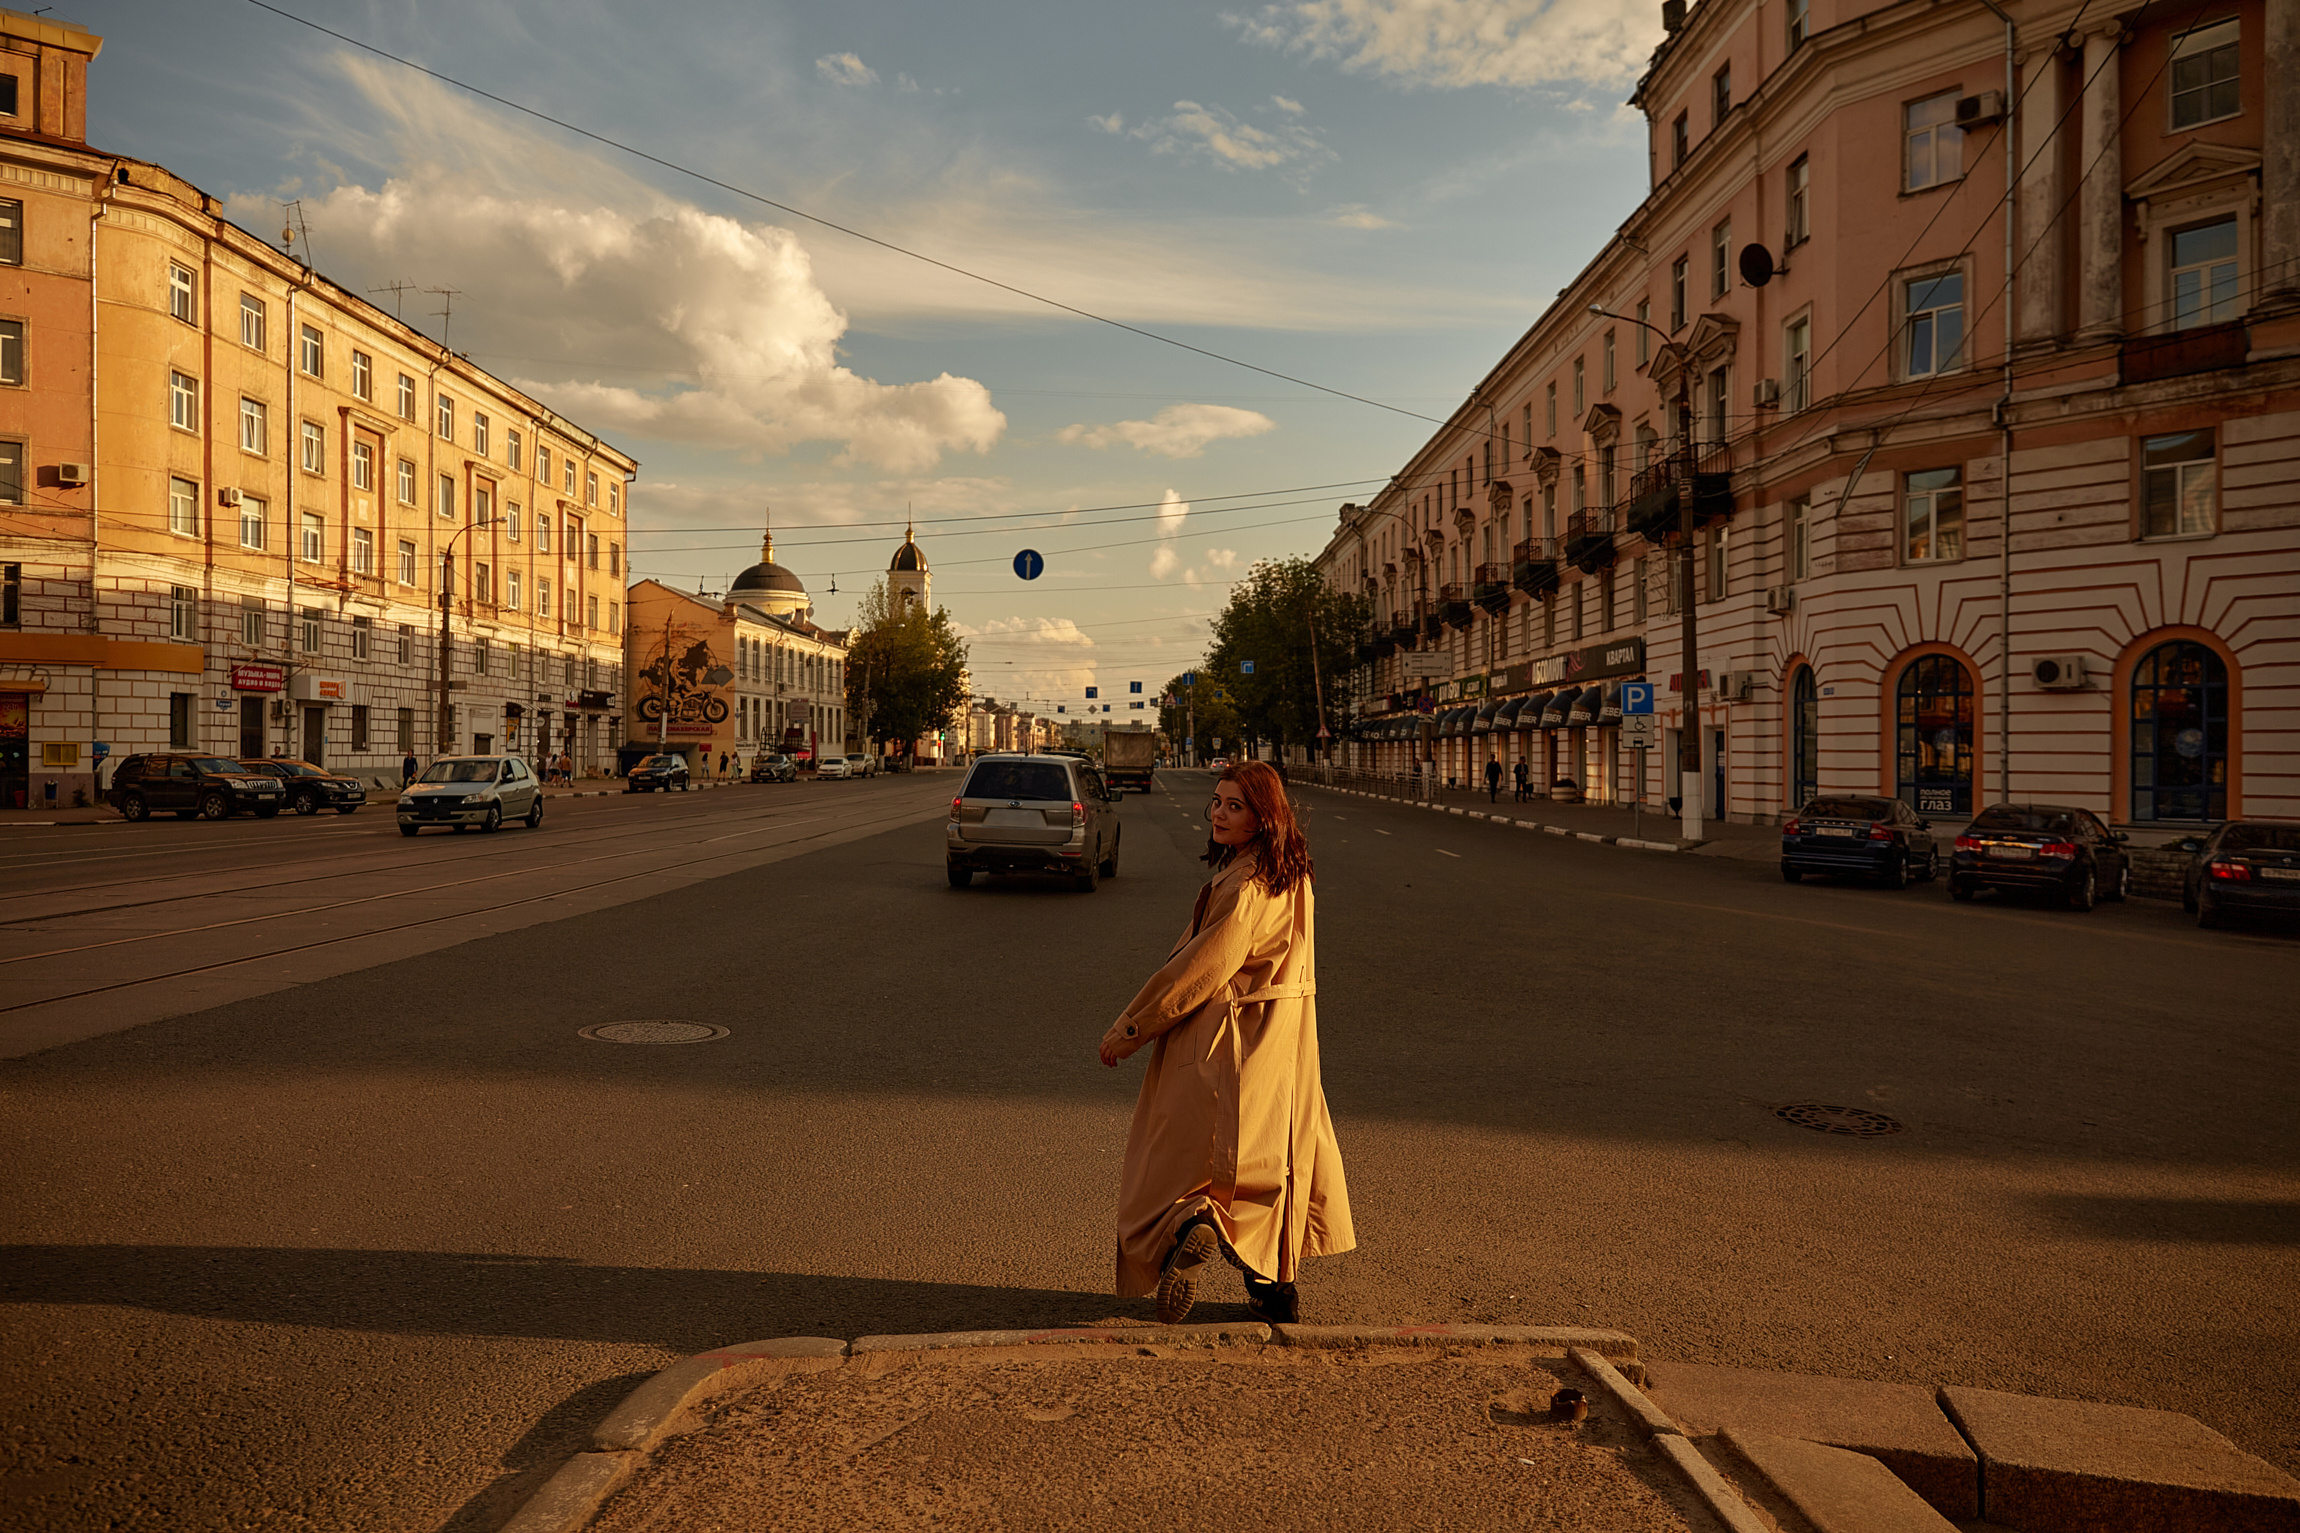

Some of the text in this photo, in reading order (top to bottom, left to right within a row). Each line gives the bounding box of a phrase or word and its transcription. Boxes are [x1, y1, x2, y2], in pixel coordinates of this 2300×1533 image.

[1606, 646, 1635, 667] КВАРТАЛ
[237, 678, 258, 687] АУДИО
[1627, 686, 1645, 711] P
[1920, 800, 1953, 811] глаз
